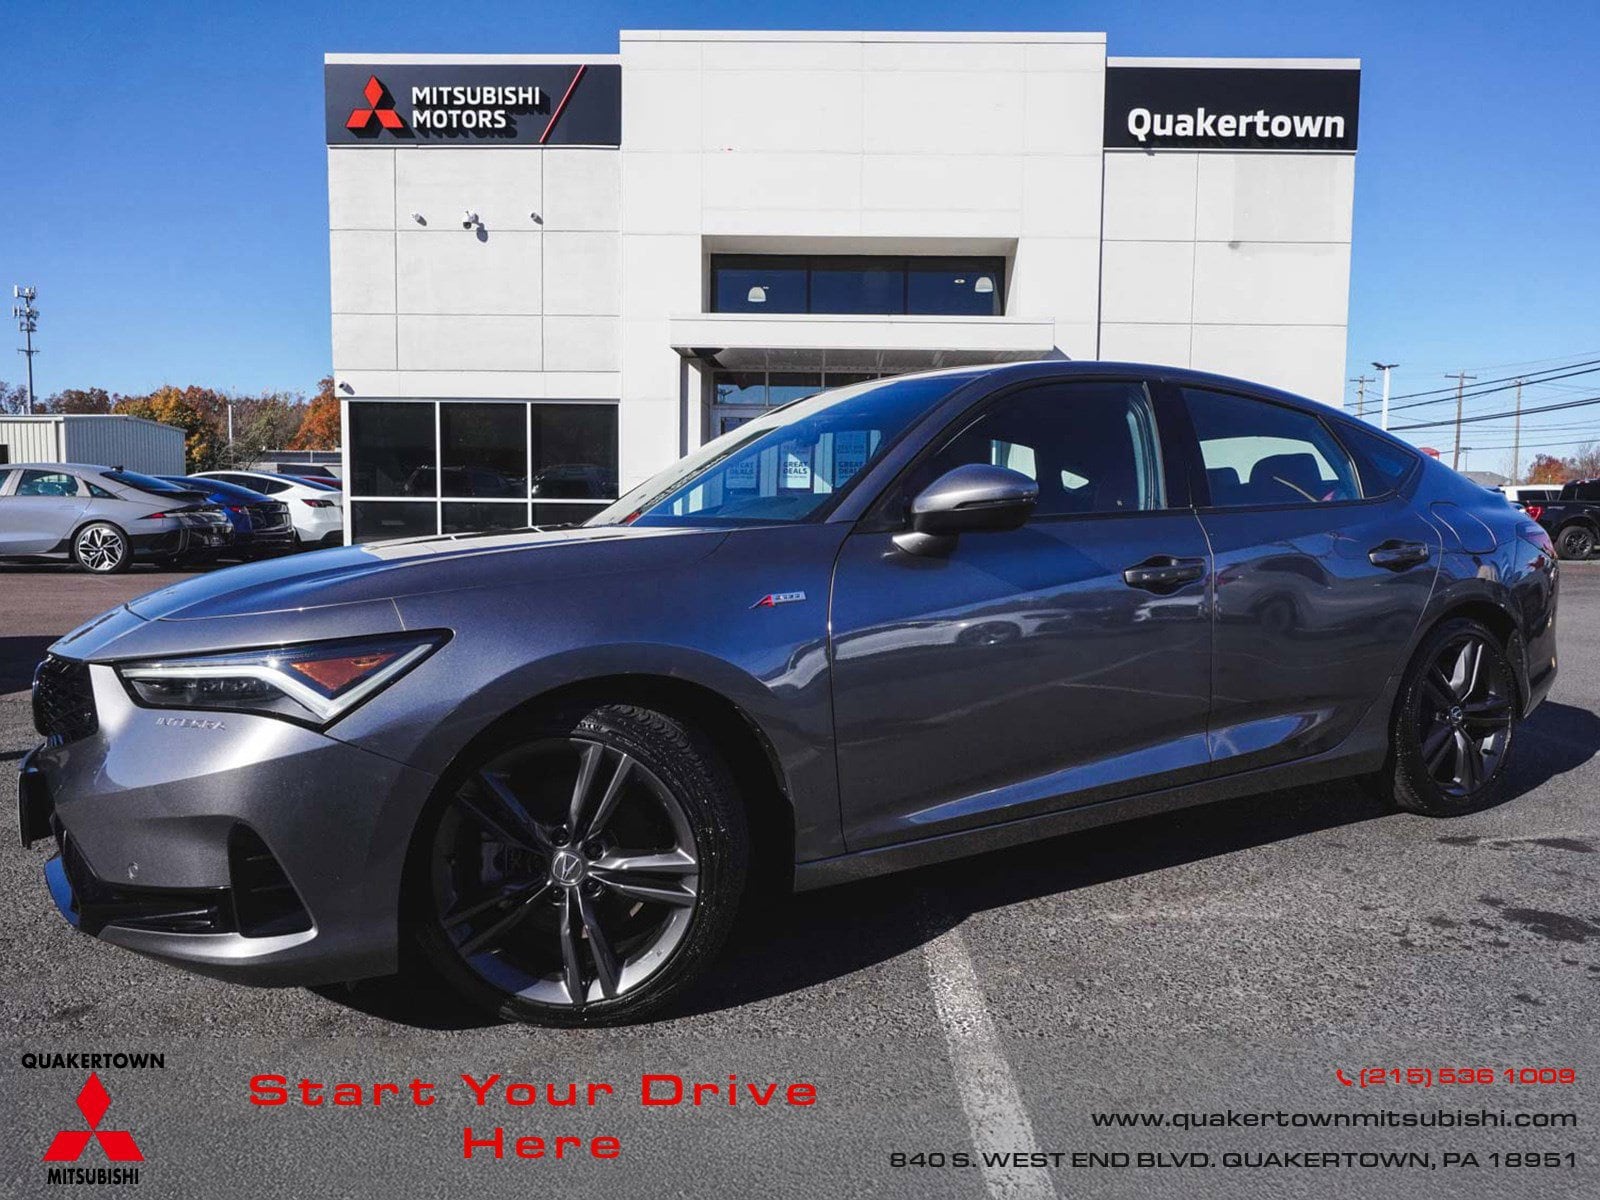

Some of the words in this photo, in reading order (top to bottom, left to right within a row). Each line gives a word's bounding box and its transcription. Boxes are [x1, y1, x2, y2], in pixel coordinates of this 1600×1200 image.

[411, 86, 541, 105] MITSUBISHI
[412, 109, 507, 129] MOTORS
[1127, 107, 1345, 142] Quakertown
[783, 467, 808, 475] DEALS
